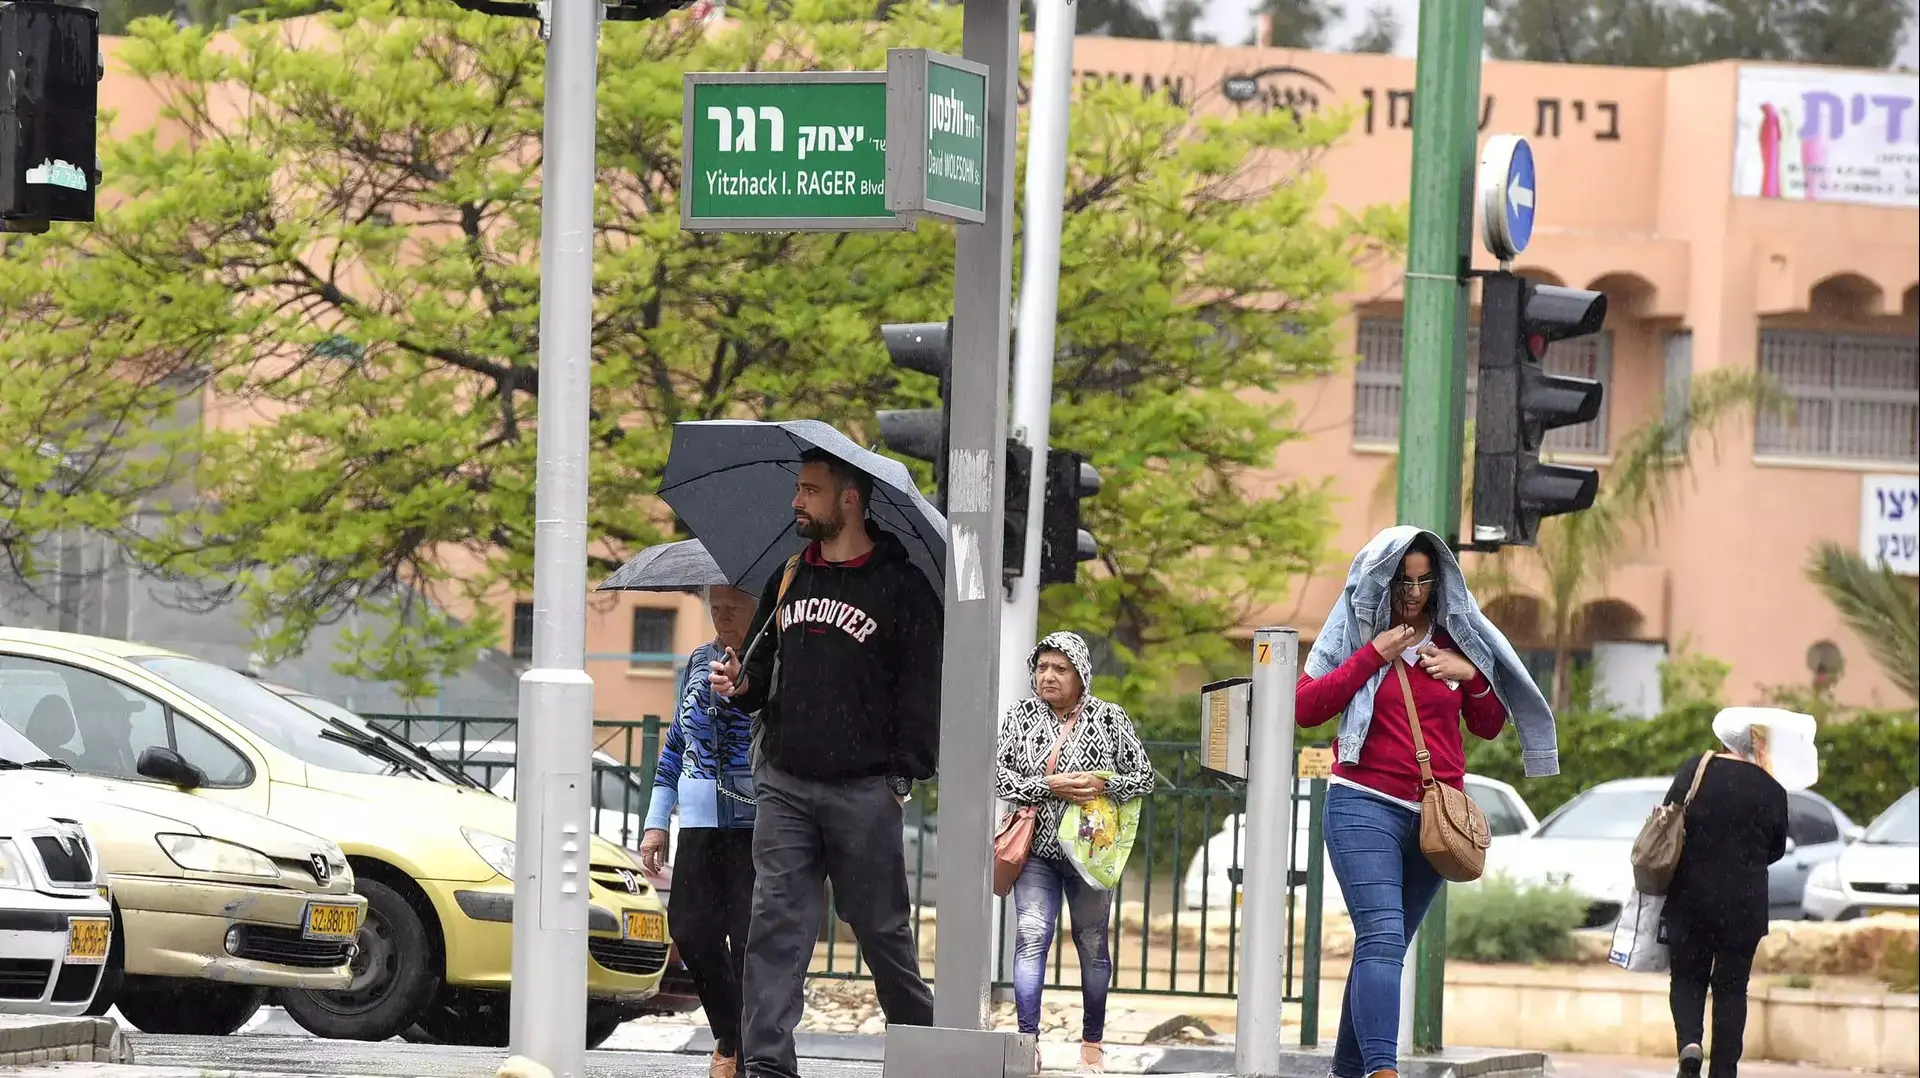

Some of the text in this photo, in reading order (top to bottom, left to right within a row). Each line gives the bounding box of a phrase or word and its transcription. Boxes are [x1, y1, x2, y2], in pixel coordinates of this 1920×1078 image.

[707, 106, 784, 154] רגר
[929, 88, 963, 140] וולפסון
[1534, 98, 1621, 140] בית
[1796, 91, 1918, 144] דית
[798, 125, 864, 160] יצחק
[706, 169, 777, 195] Yitzhack
[782, 171, 791, 195] I.
[797, 171, 856, 195] RAGER
[928, 149, 943, 176] David
[944, 152, 974, 184] WOLFSOHN
[1258, 644, 1269, 663] 7
